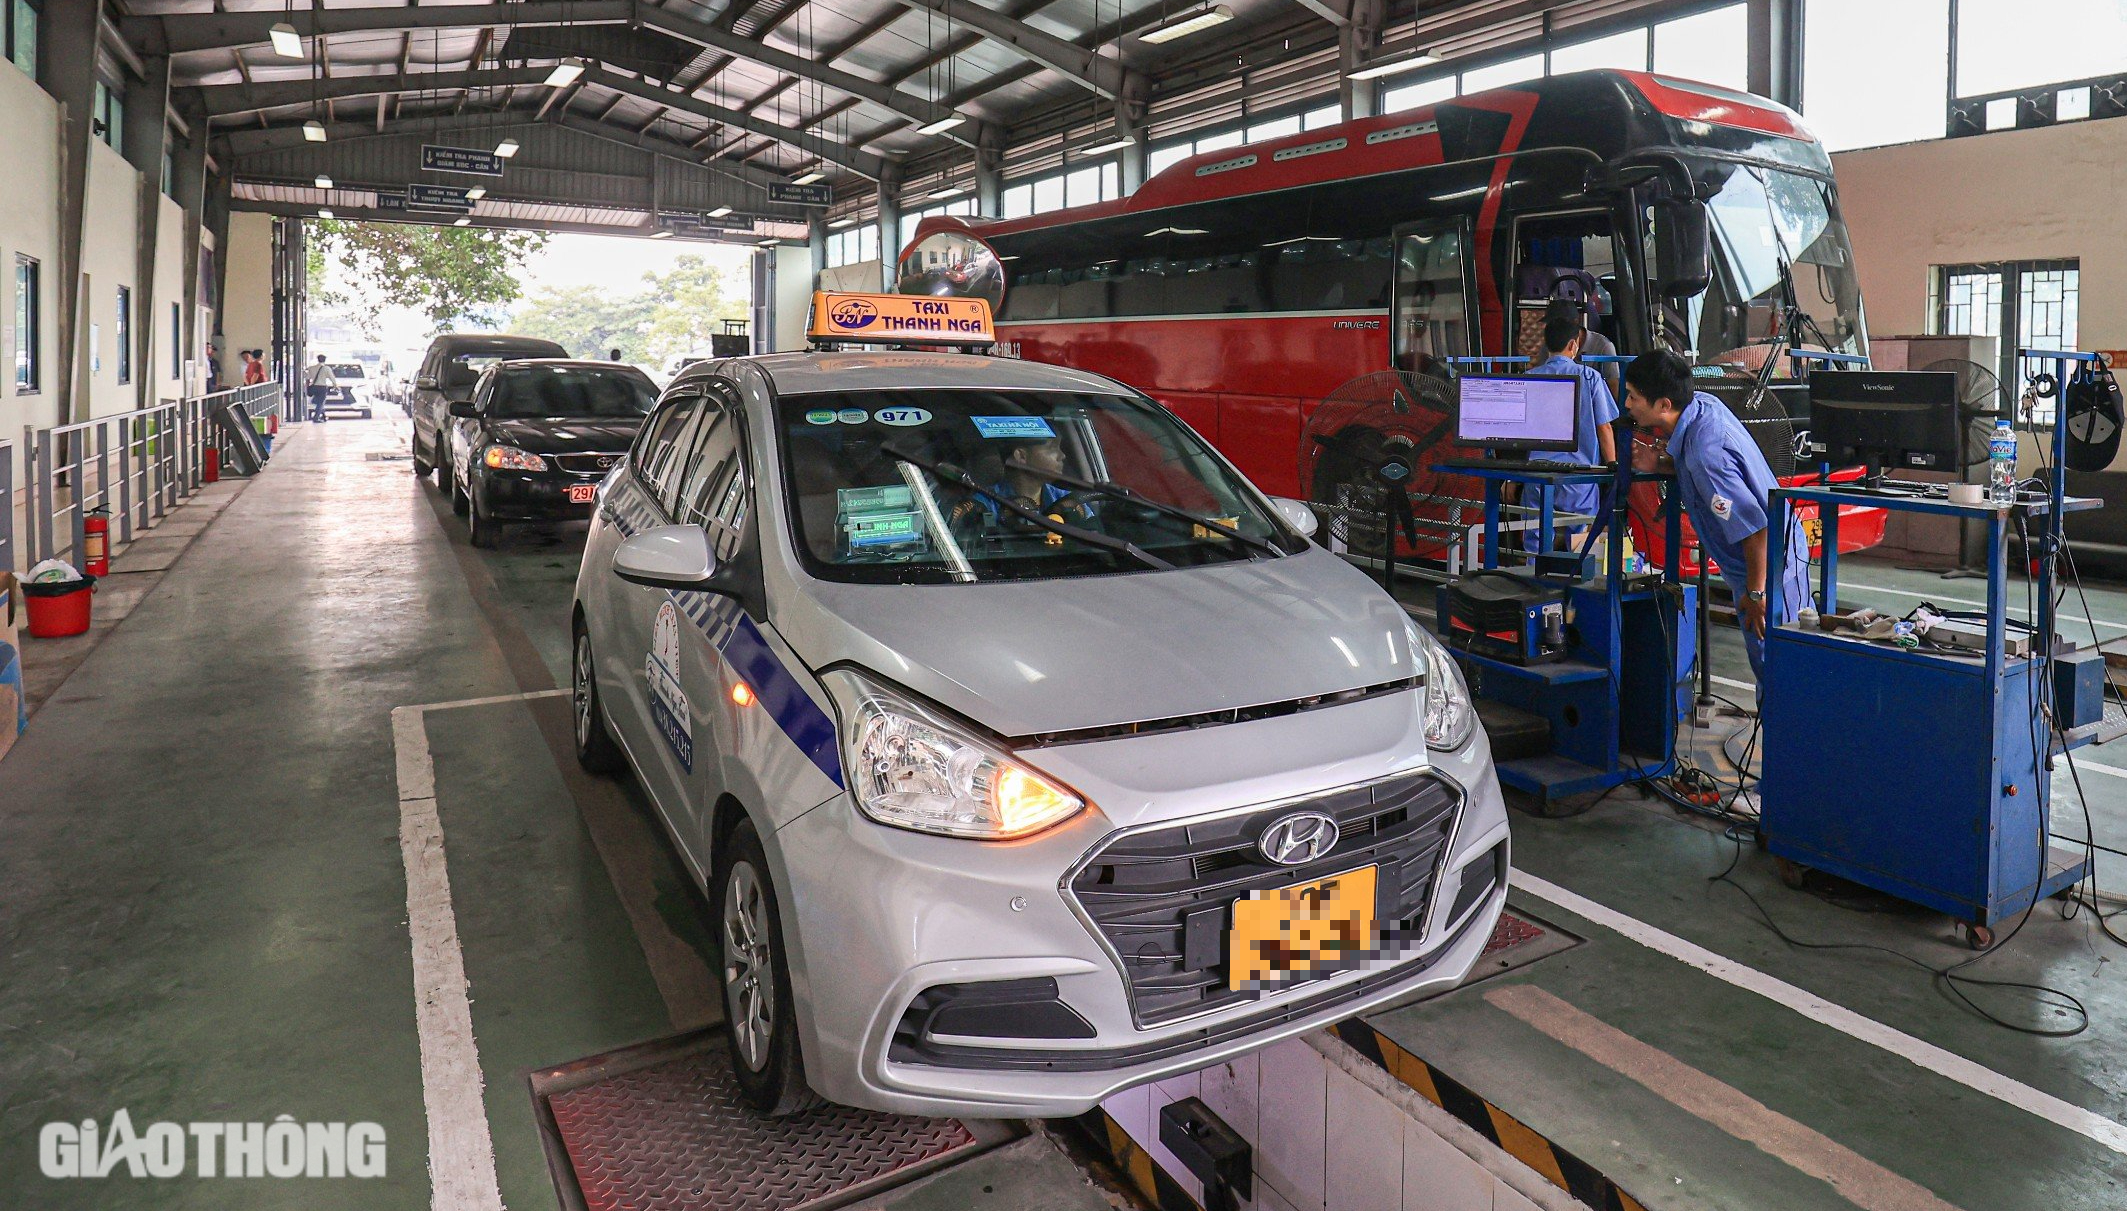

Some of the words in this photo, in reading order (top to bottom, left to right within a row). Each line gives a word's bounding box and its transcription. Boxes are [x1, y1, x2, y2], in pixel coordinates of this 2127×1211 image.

[912, 301, 949, 315] TAXI
[882, 316, 940, 331] THANH
[948, 318, 981, 333] NGA
[1862, 383, 1895, 391] ViewSonic
[881, 410, 924, 422] 971
[891, 520, 909, 530] NGA
